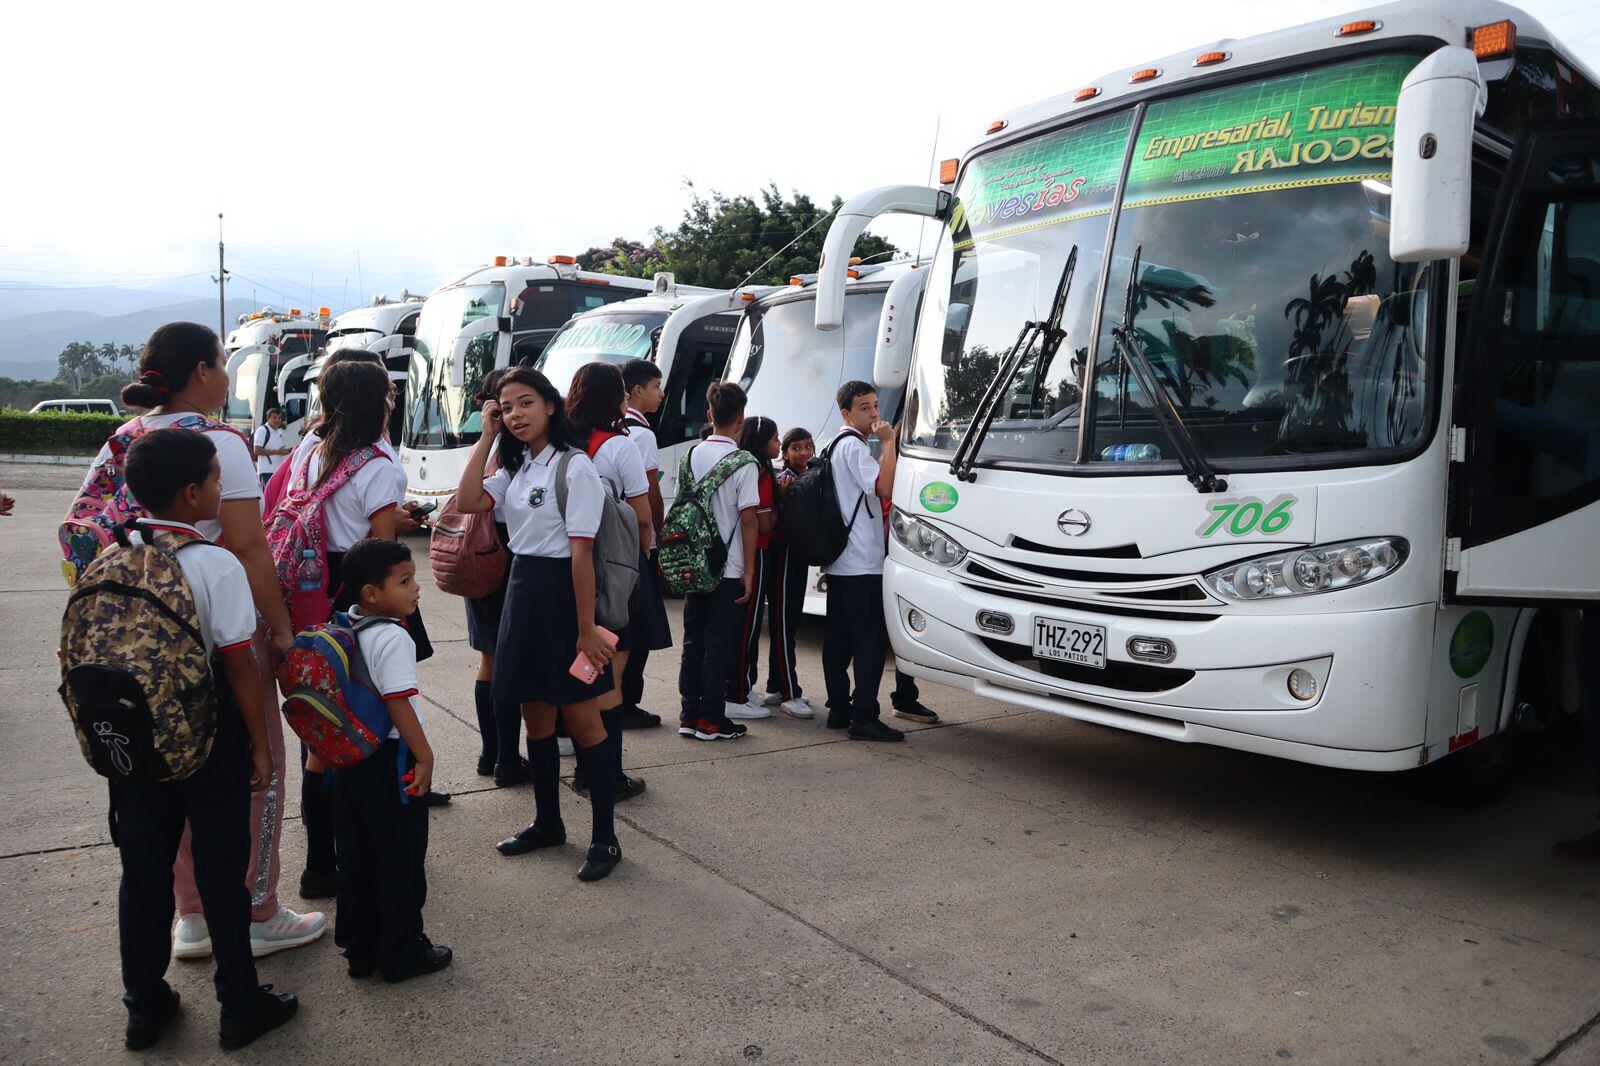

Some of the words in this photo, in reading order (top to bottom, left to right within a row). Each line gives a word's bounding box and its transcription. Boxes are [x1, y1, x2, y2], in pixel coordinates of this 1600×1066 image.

[1143, 111, 1293, 160] Empresarial,
[1306, 101, 1396, 132] Turism
[1200, 498, 1297, 537] 706
[1036, 623, 1066, 650] THZ
[1070, 629, 1103, 657] 292
[1048, 649, 1060, 657] LOS
[1064, 651, 1088, 662] PATIOS
